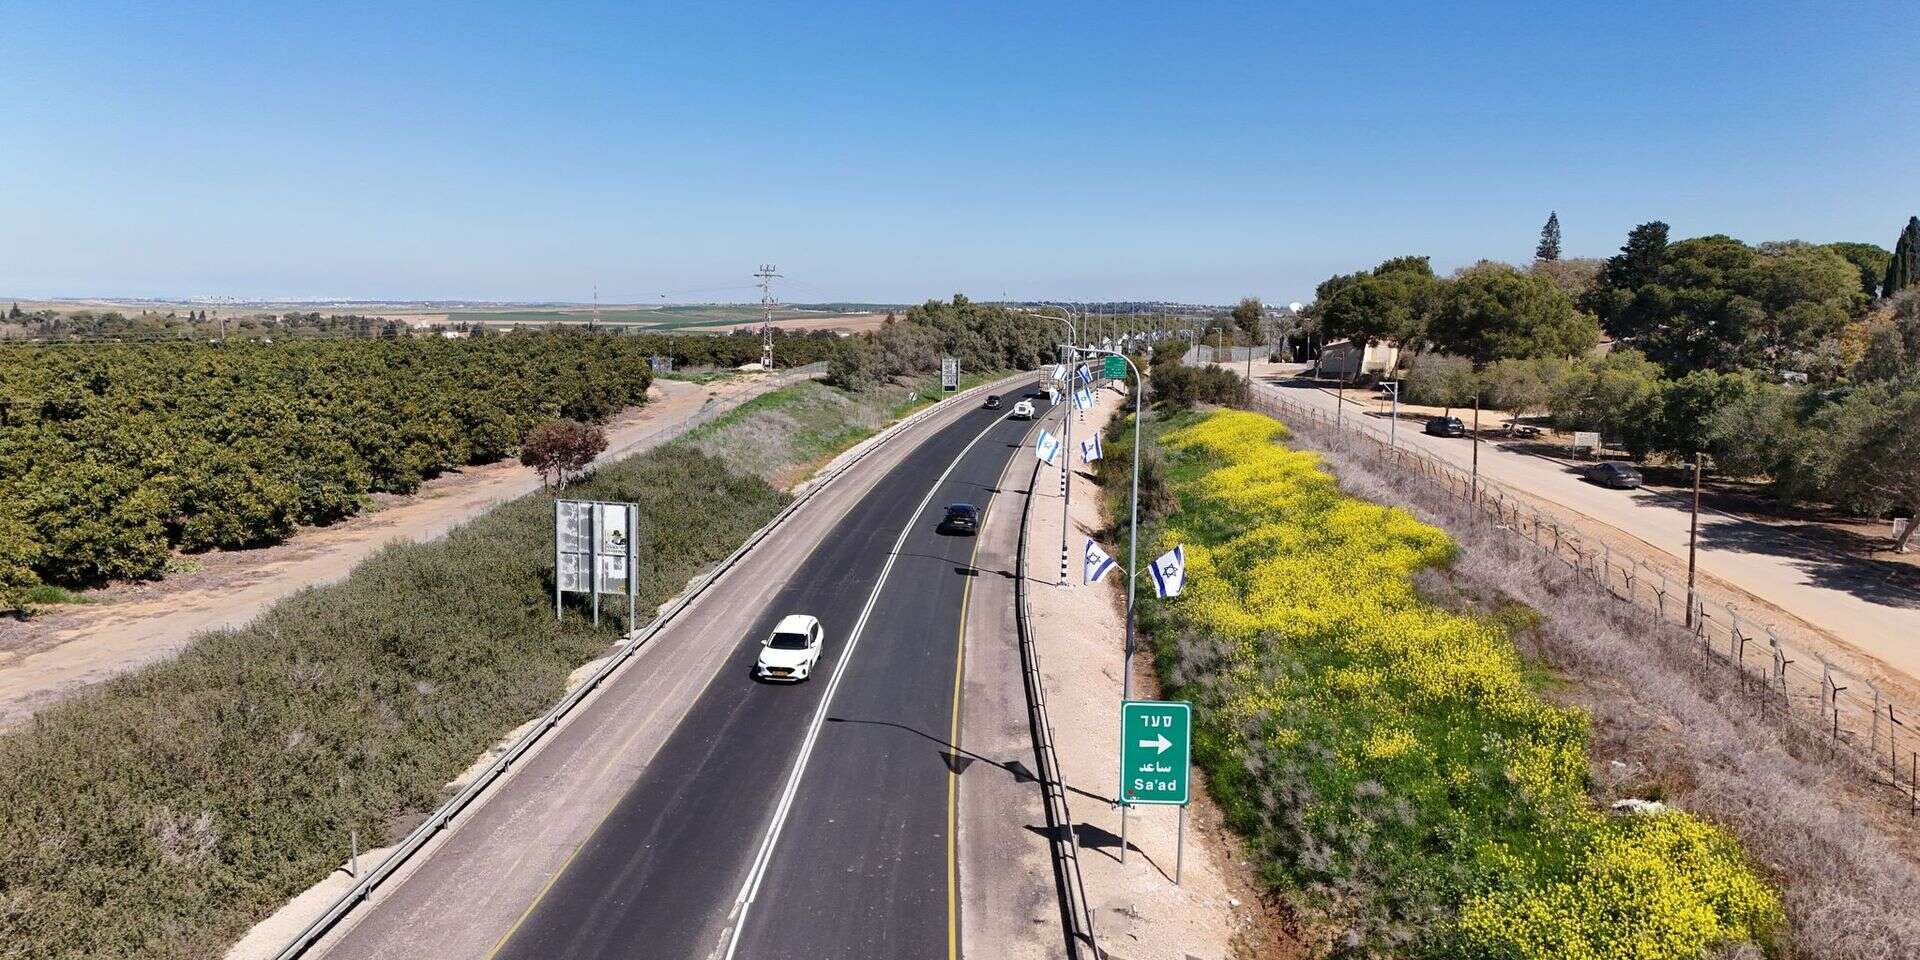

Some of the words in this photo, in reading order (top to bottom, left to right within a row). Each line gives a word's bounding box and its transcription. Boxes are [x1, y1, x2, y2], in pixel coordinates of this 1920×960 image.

[1140, 715, 1172, 727] סעד
[1139, 761, 1172, 773] ساعد
[1134, 778, 1177, 791] Sa'ad
